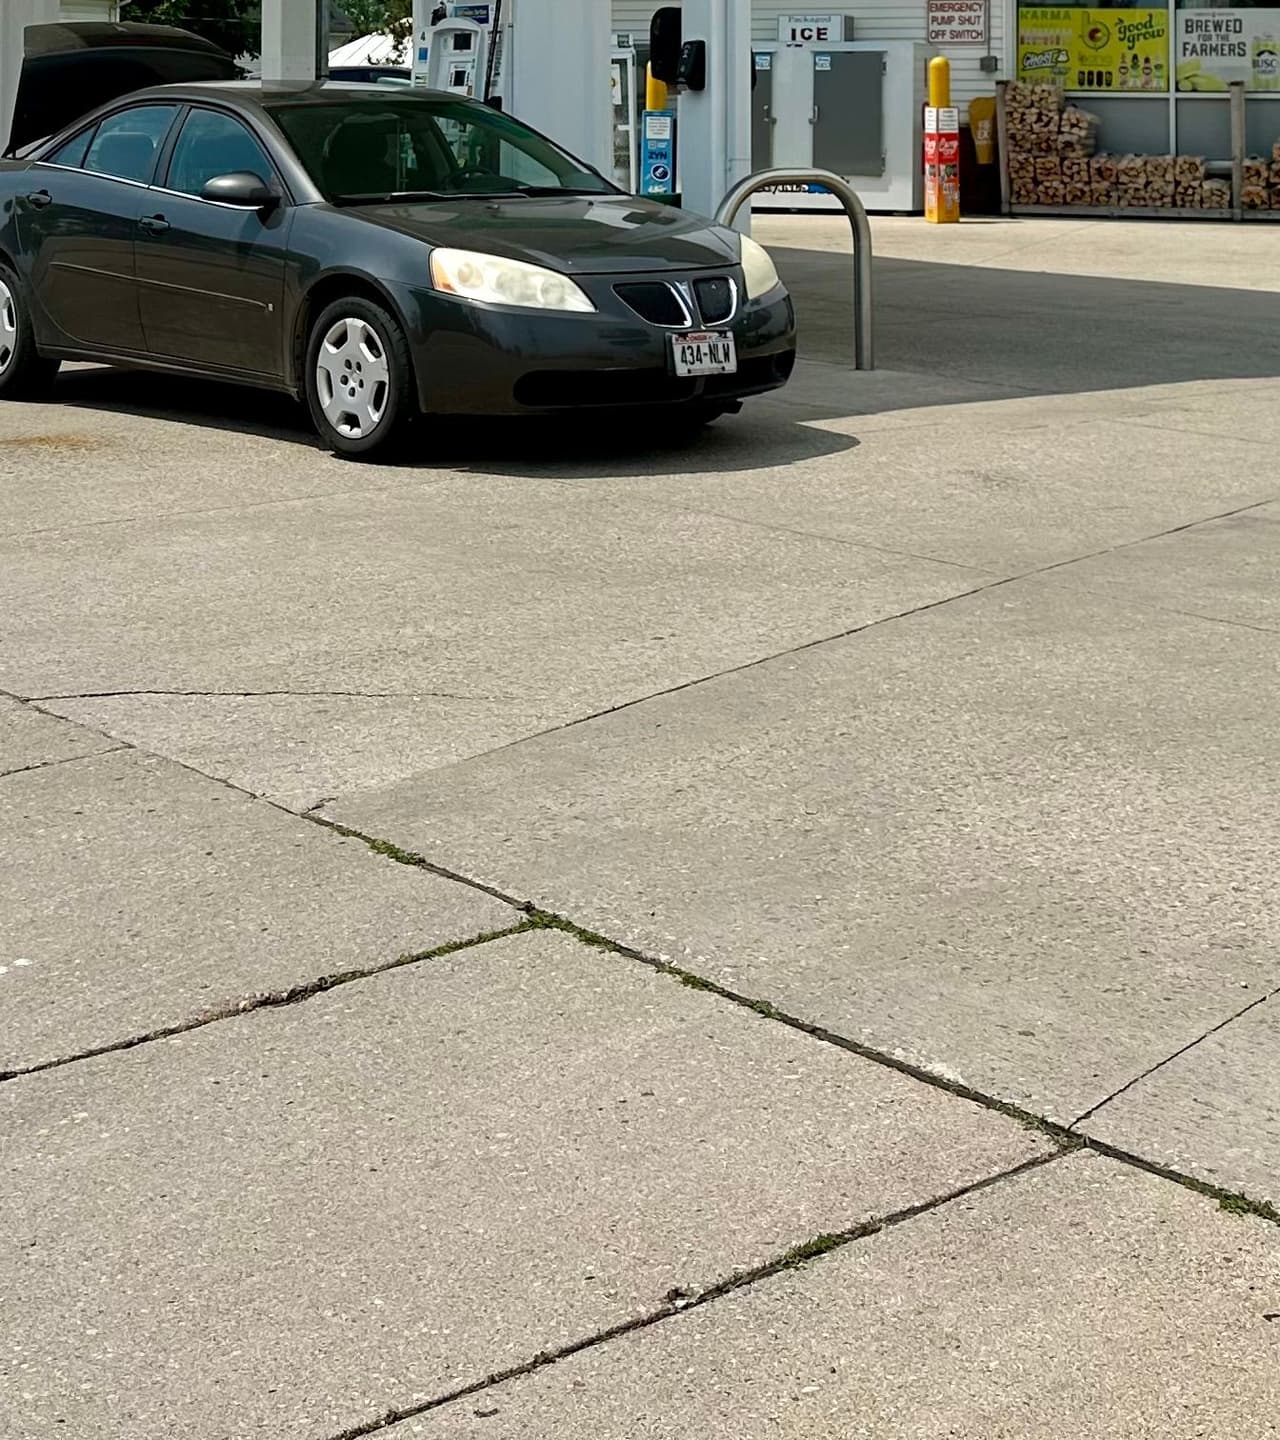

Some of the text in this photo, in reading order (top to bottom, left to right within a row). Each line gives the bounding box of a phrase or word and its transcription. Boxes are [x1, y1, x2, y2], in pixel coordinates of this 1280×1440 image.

[929, 3, 984, 13] EMERGENCY
[930, 15, 982, 26] PUMP SHUT
[1020, 10, 1071, 21] KARMA
[1116, 14, 1154, 41] good
[1185, 18, 1243, 34] BREWED
[791, 27, 828, 41] ICE
[930, 29, 984, 40] OFF SWITCH
[1127, 27, 1165, 50] grow
[1197, 33, 1230, 42] FOR THE
[1182, 41, 1247, 57] FARMERS
[647, 151, 669, 160] ZYN
[680, 343, 731, 366] 434-NLW
